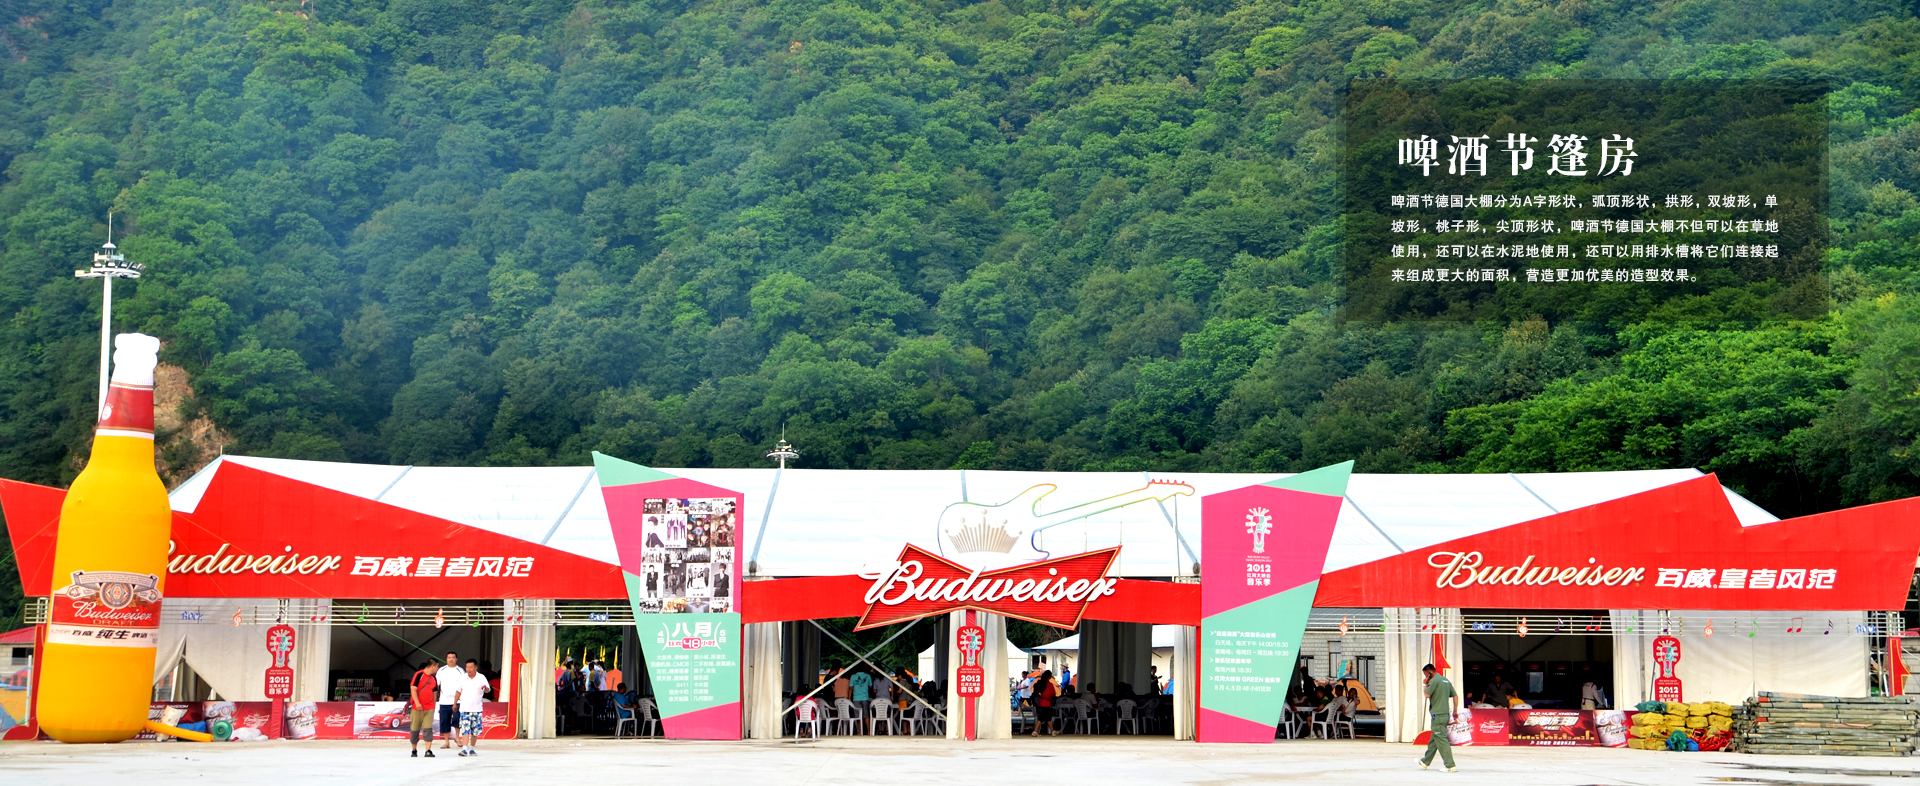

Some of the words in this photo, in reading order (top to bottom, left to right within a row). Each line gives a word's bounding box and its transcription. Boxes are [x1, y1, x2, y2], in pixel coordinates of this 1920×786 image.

[166, 540, 342, 575] udweiser
[1247, 564, 1271, 572] 2012
[1427, 550, 1645, 588] Budweiser
[857, 560, 1116, 605] Budweiser
[73, 601, 152, 620] Budweiser
[671, 622, 711, 638] 八月
